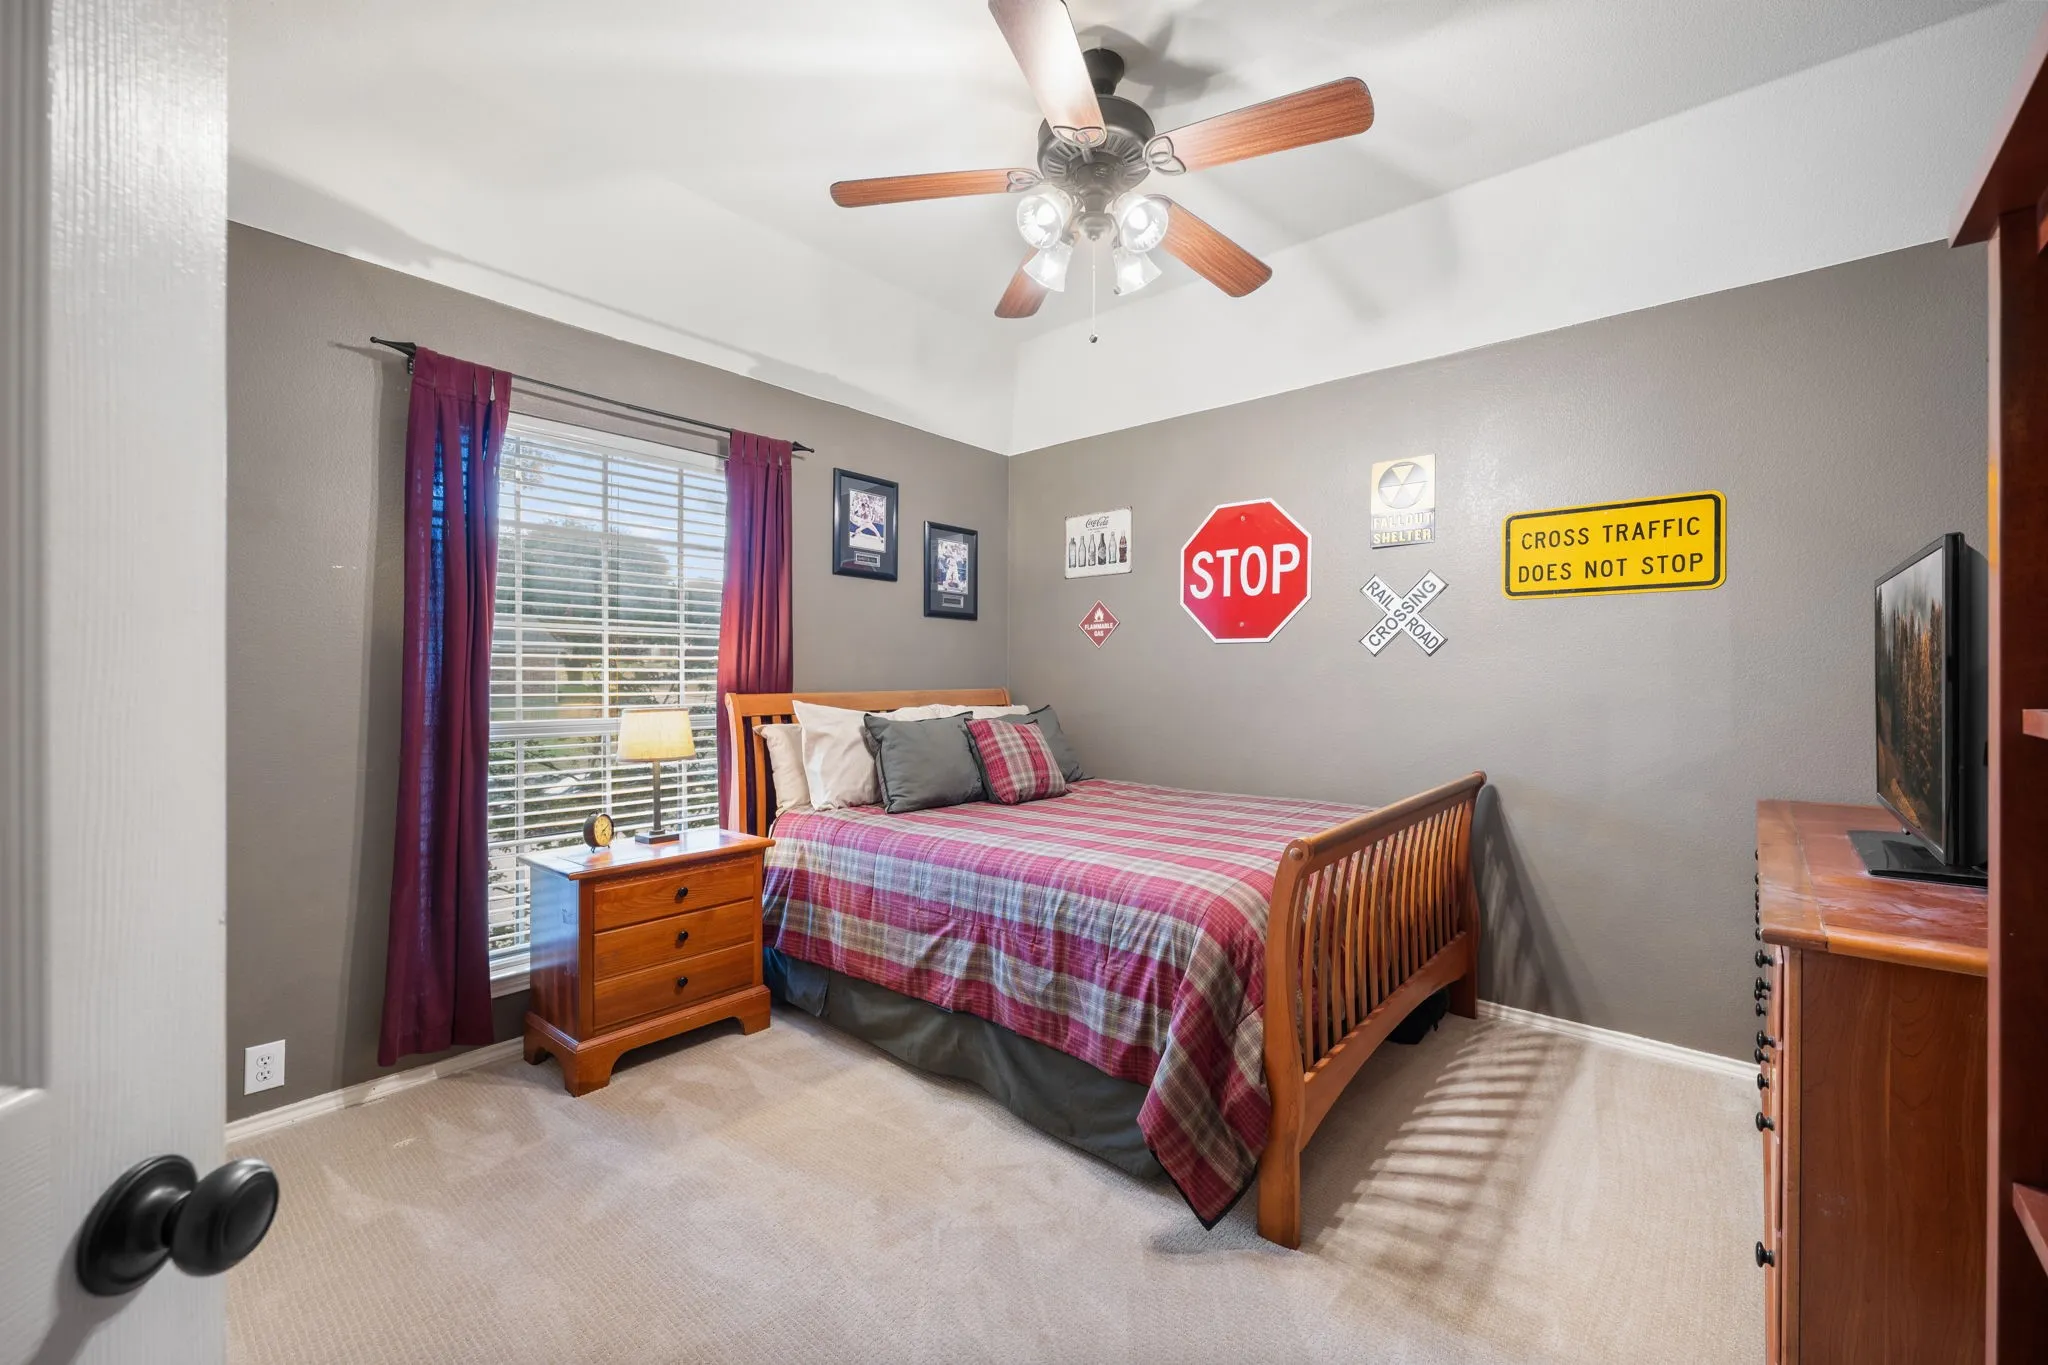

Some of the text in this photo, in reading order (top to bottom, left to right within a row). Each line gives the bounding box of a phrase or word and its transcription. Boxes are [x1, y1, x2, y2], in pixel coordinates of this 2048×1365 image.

[1373, 512, 1433, 530] FALLOUT
[1373, 528, 1433, 544] SHELTER
[1521, 516, 1701, 550] CROSS TRAFFIC
[1190, 543, 1301, 599] STOP
[1518, 552, 1703, 583] DOES NOT STOP
[1084, 622, 1114, 630] FLAMMABLE
[1366, 581, 1439, 650] RAIL ROAD
[1368, 579, 1437, 647] CROSSING
